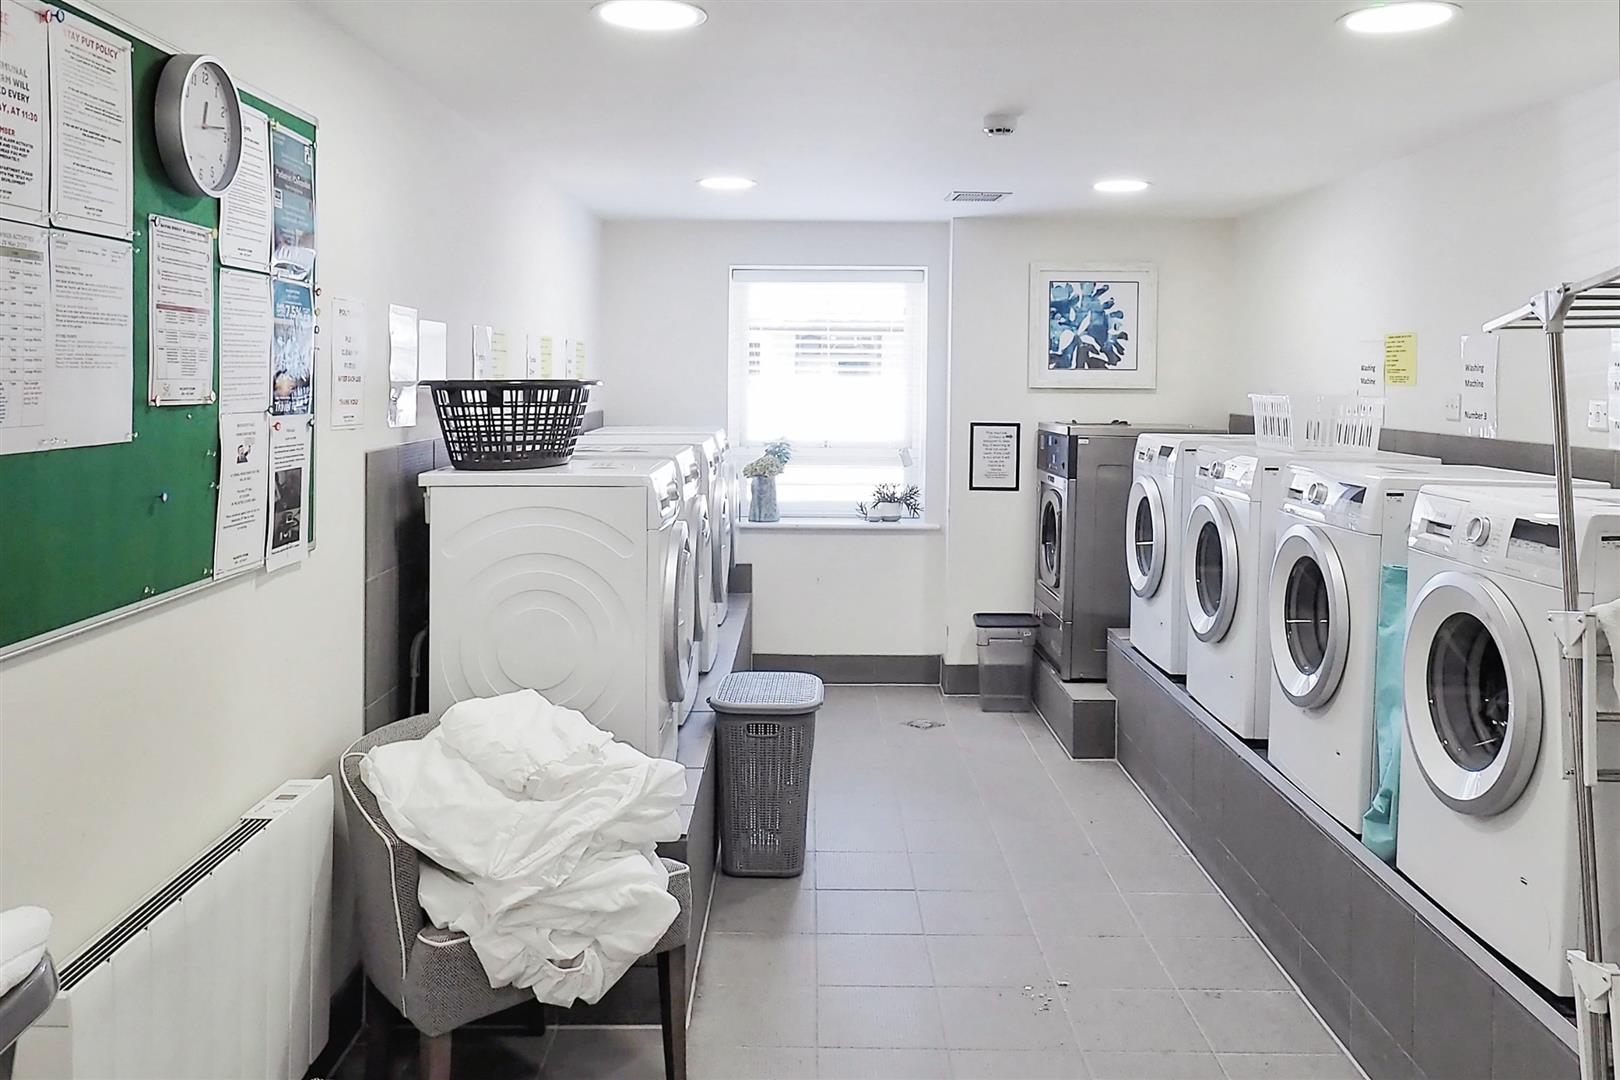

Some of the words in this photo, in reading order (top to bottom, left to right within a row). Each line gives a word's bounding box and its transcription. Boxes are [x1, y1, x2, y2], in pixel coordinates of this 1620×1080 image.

[81, 36, 95, 50] PUT
[95, 42, 118, 60] POLICY
[12, 78, 30, 92] WILL
[8, 89, 30, 103] EVERY
[11, 106, 21, 116] AT
[21, 110, 38, 122] 11:30
[1464, 364, 1484, 374] Washing
[1464, 379, 1484, 388] Machine
[1464, 410, 1483, 420] Number
